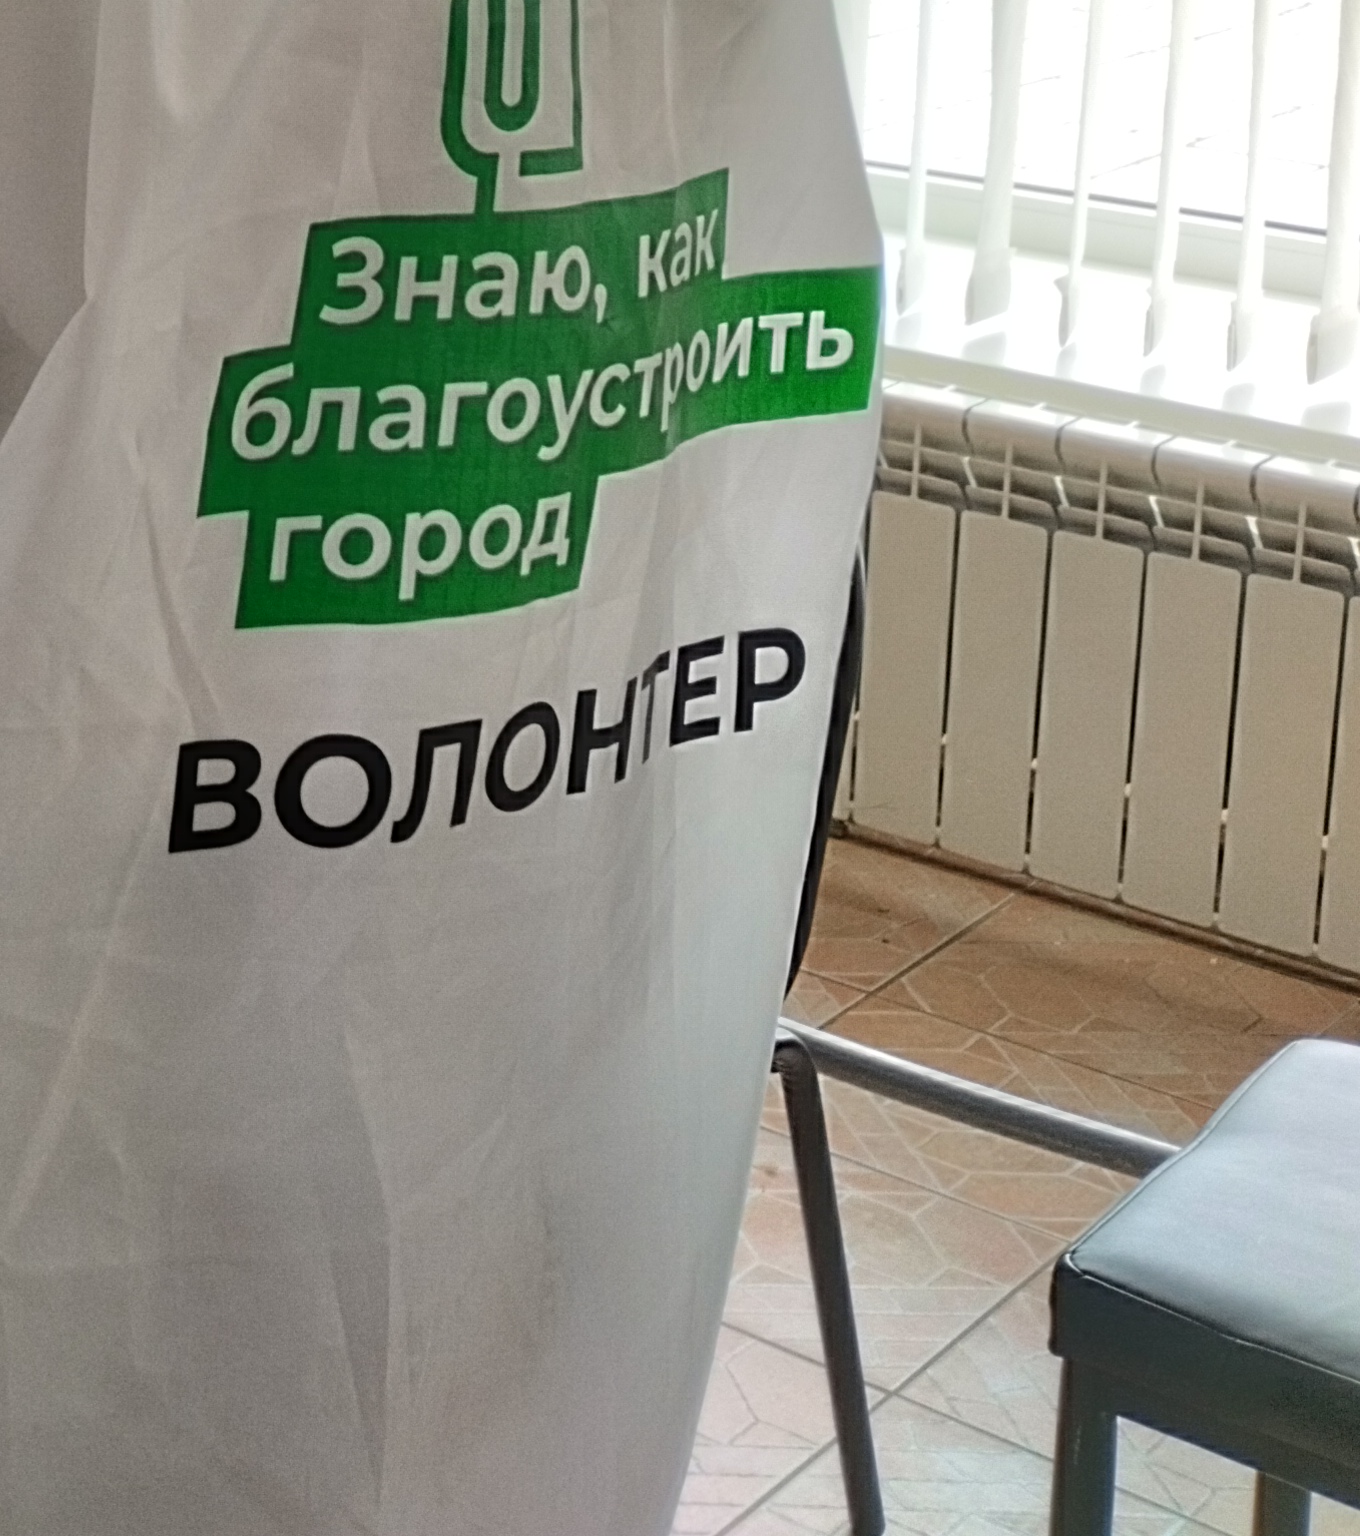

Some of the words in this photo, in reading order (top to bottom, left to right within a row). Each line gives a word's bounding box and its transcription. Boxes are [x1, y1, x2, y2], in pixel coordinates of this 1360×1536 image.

[318, 235, 608, 325] Знаю,
[637, 208, 720, 298] как
[229, 310, 855, 462] благоустроить
[268, 491, 573, 601] город
[167, 626, 807, 854] ВОЛОНТЕР
